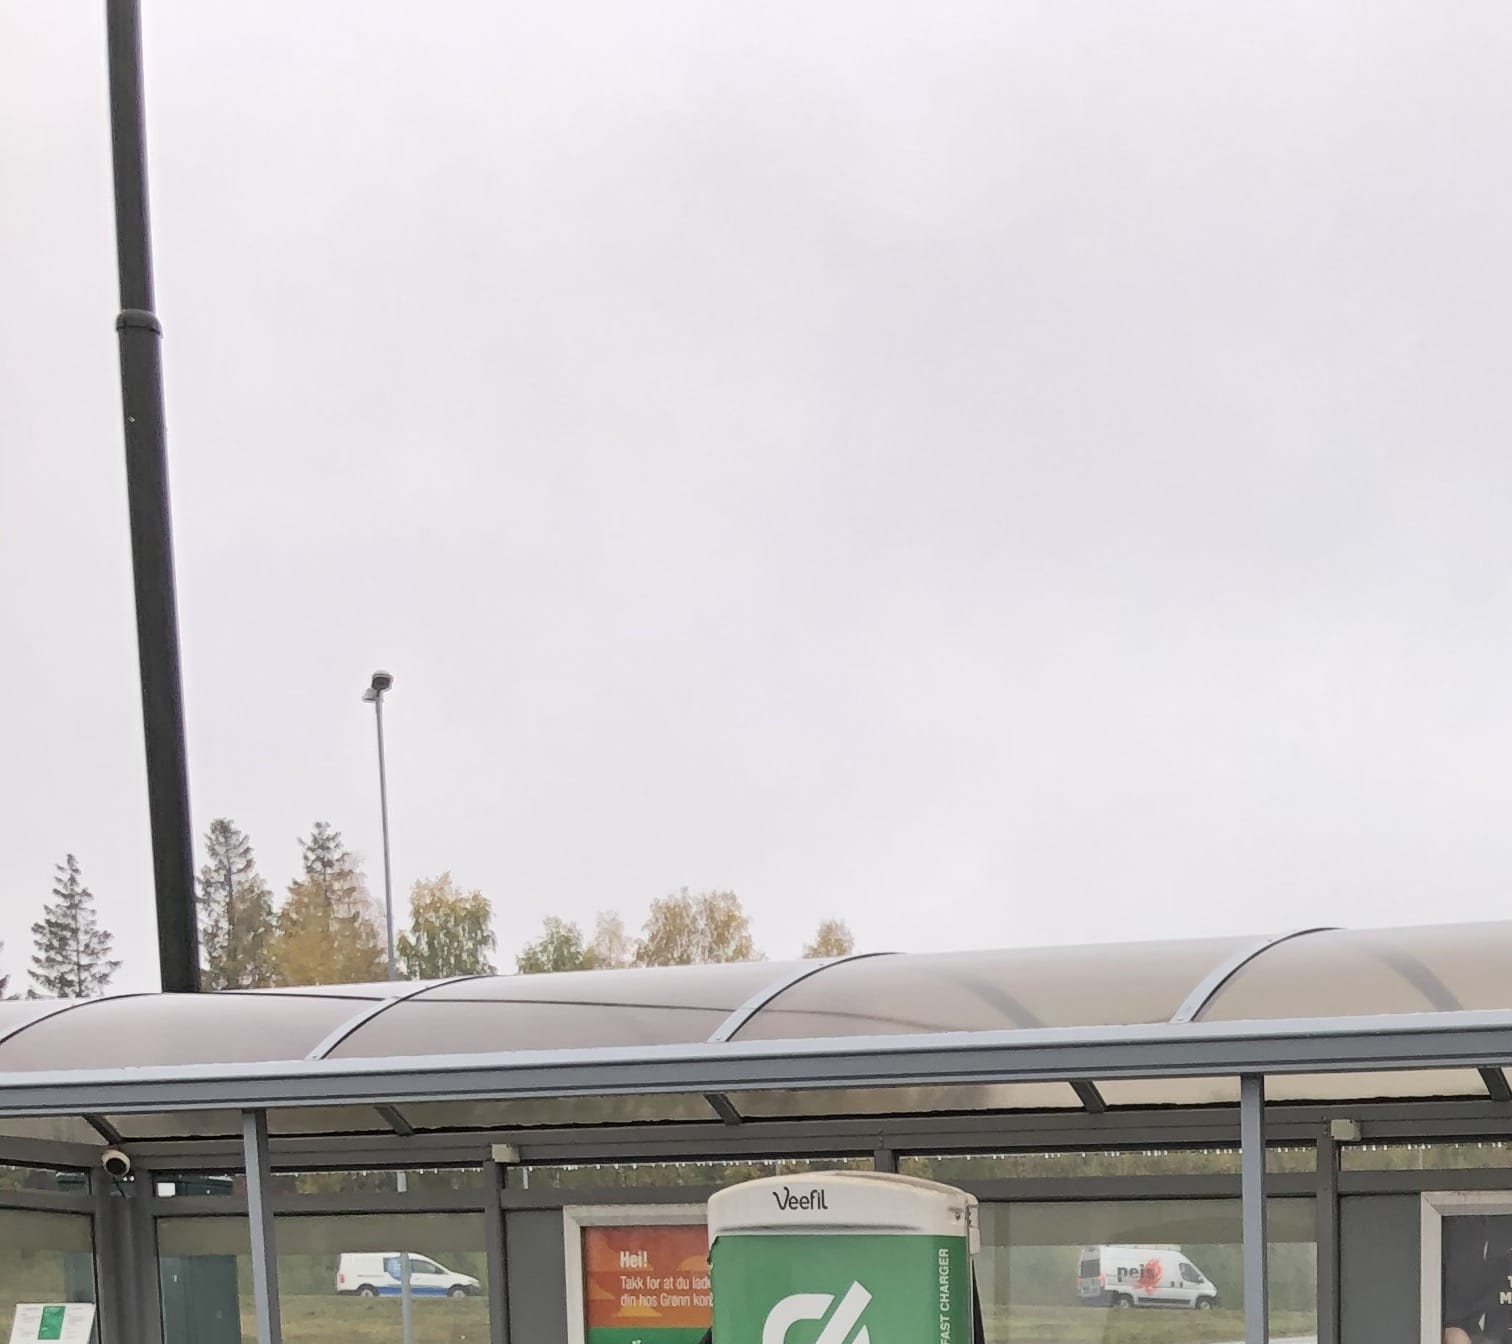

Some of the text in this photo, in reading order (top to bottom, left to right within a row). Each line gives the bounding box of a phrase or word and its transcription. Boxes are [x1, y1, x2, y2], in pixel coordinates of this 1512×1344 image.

[772, 1186, 828, 1211] Veefil
[620, 1250, 648, 1268] Hei!
[620, 1276, 644, 1290] Takk
[646, 1276, 661, 1290] for
[663, 1276, 674, 1290] at
[676, 1275, 690, 1290] du
[938, 1248, 950, 1311] CHARGER
[620, 1293, 637, 1307] din
[639, 1293, 658, 1307] hos
